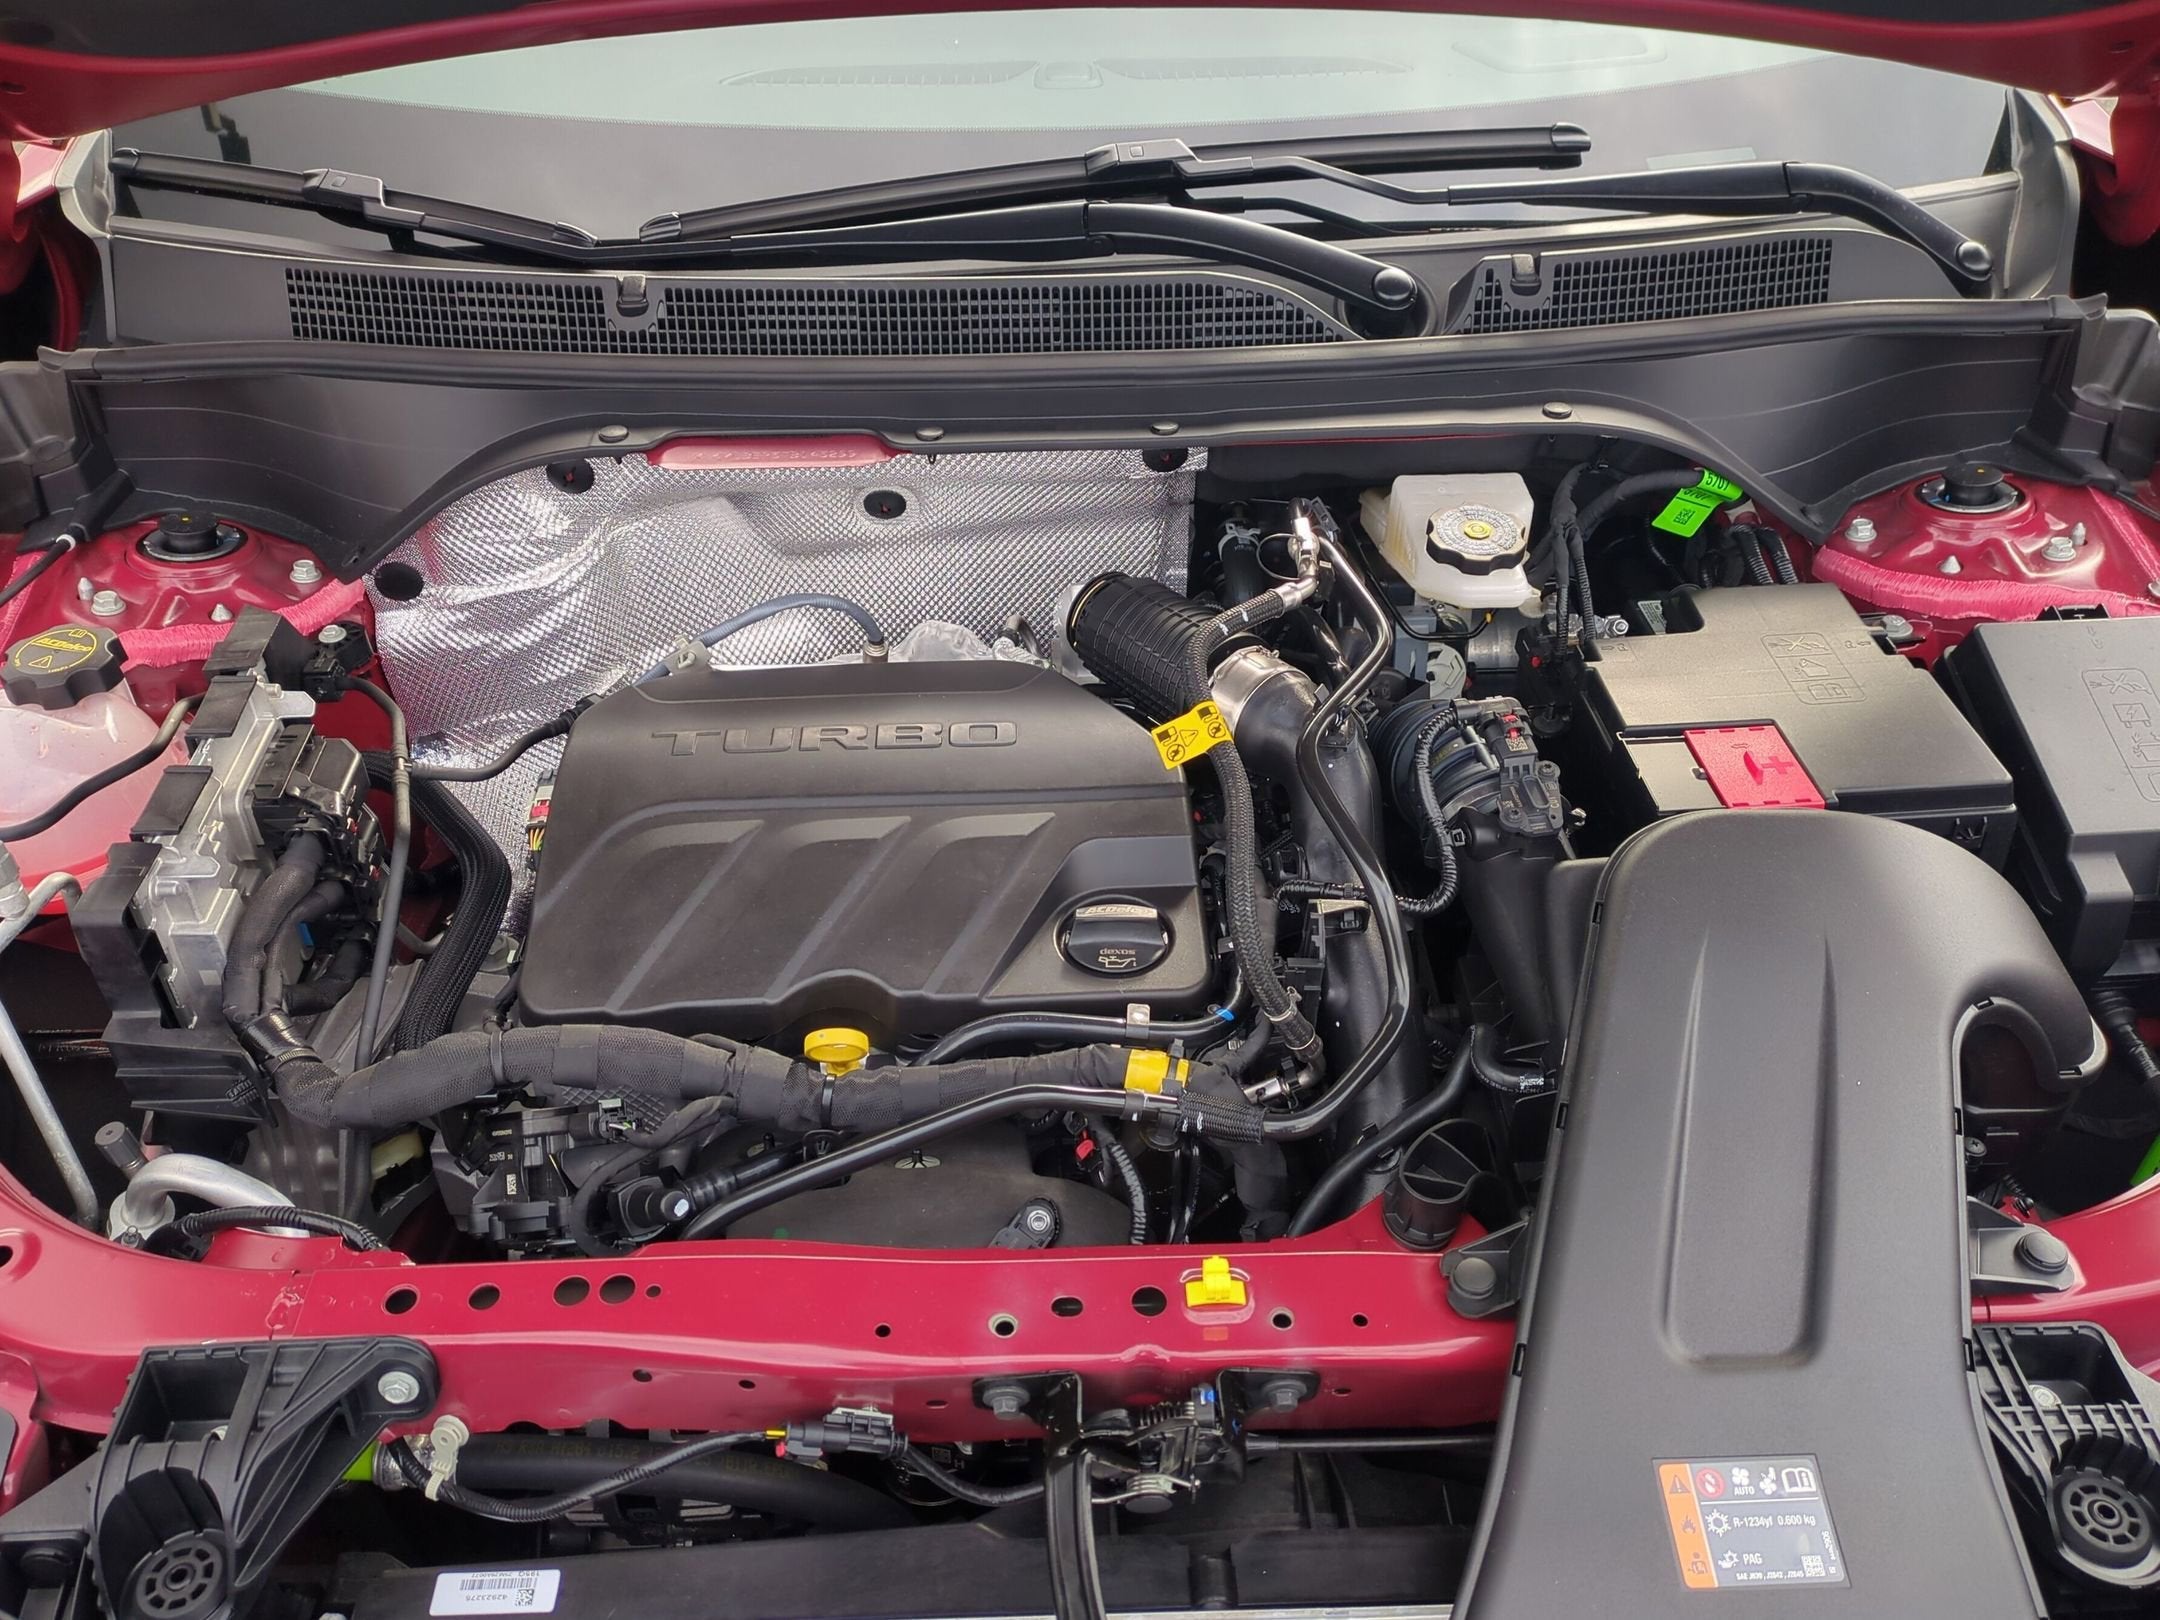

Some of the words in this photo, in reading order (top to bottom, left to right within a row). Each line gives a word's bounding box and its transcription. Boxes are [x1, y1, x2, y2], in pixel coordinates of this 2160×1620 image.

[33, 637, 93, 652] ACDelco
[651, 722, 1018, 757] TURBO
[1100, 947, 1136, 955] dexos
[1734, 1486, 1755, 1496] AUTO
[1733, 1515, 1773, 1528] R-1234yf
[1777, 1514, 1802, 1526] 0.600
[1803, 1514, 1816, 1527] kg
[1743, 1553, 1763, 1565] PAG
